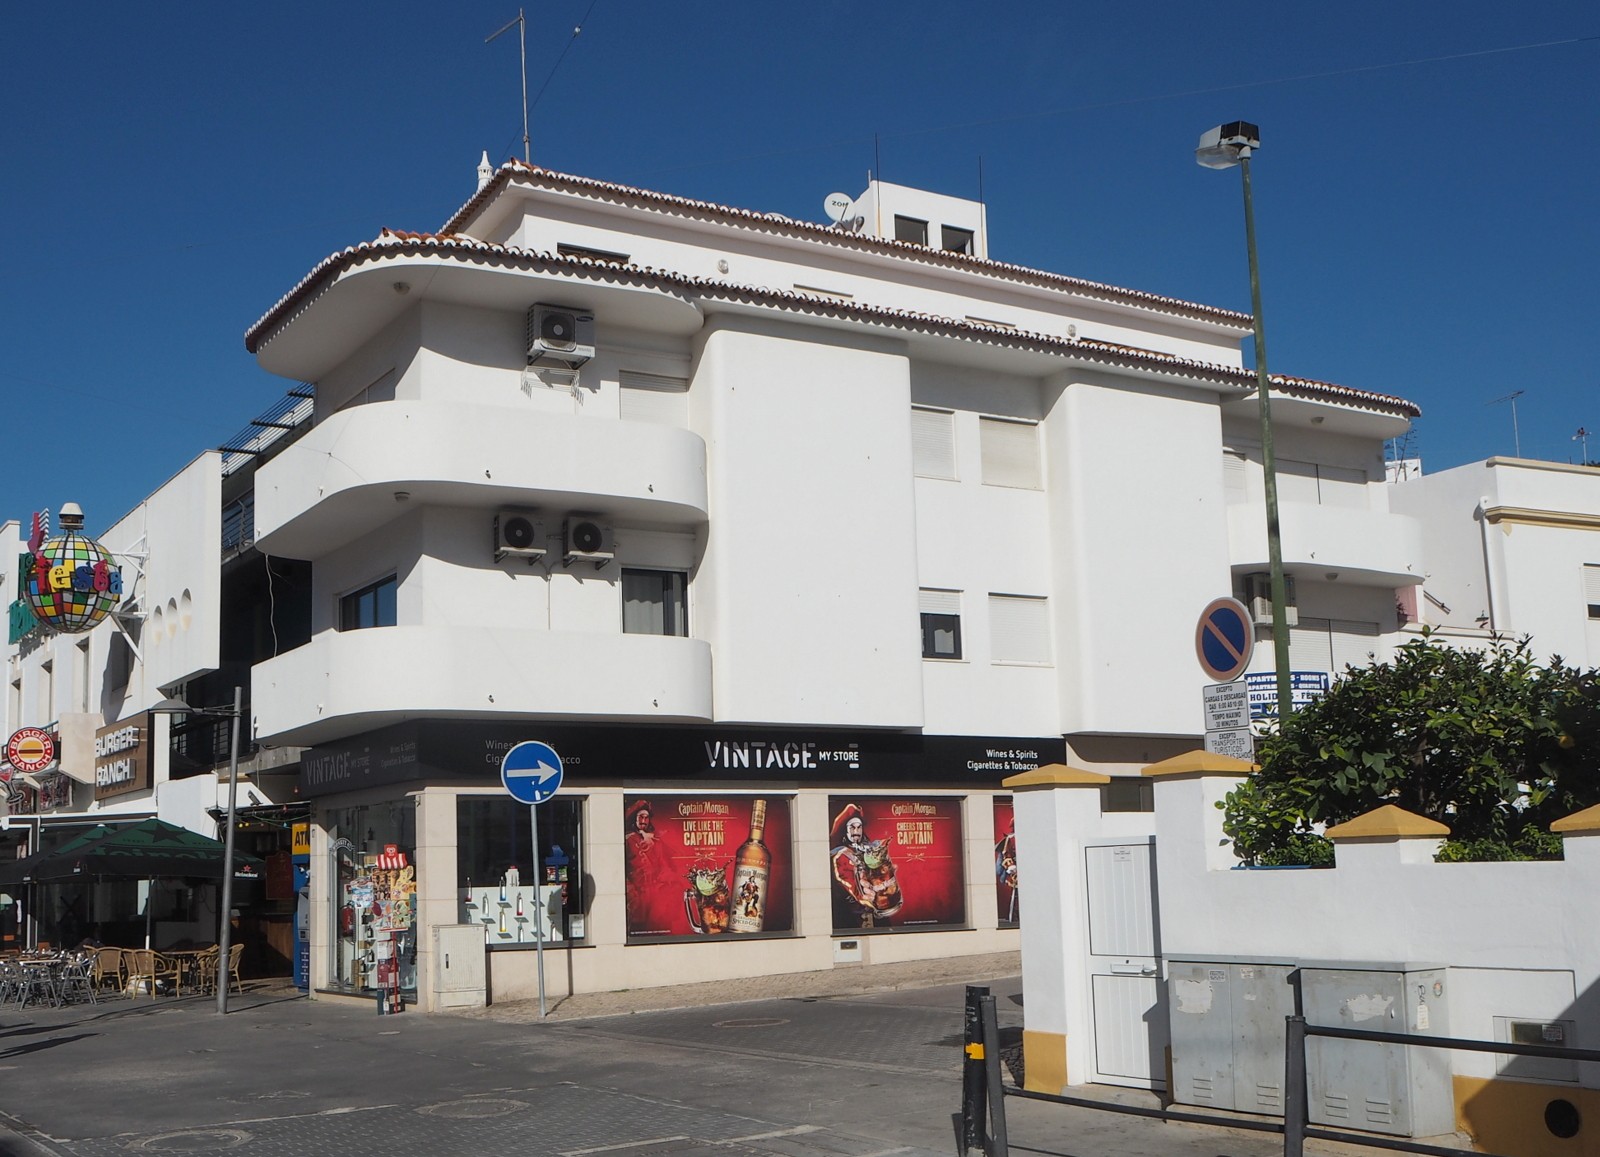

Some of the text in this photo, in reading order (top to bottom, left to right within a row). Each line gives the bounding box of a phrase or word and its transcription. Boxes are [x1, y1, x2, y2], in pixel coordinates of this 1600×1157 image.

[1224, 692, 1246, 701] DESCARGAS
[1250, 692, 1294, 701] HOLIDS
[10, 730, 52, 750] BURGER
[96, 726, 135, 758] BURGER
[485, 740, 514, 750] Wines
[1211, 738, 1245, 747] TRANSPORTES
[704, 741, 859, 768] VINTAGE MY STORE
[986, 749, 1038, 760] Wines & Spirits
[11, 755, 53, 771] RANCH
[306, 752, 350, 786] VINTAGE
[967, 761, 1039, 771] Cigarettes & Tobacco
[96, 758, 131, 788] RANCH
[678, 801, 729, 816] Captain Morgan
[891, 802, 936, 816] Captain Morgan
[683, 820, 724, 831] LIVE LIKE THE
[896, 821, 933, 831] CHEERS TO THE
[683, 831, 724, 846] CAPTAIN
[897, 831, 934, 845] CAPTAIN
